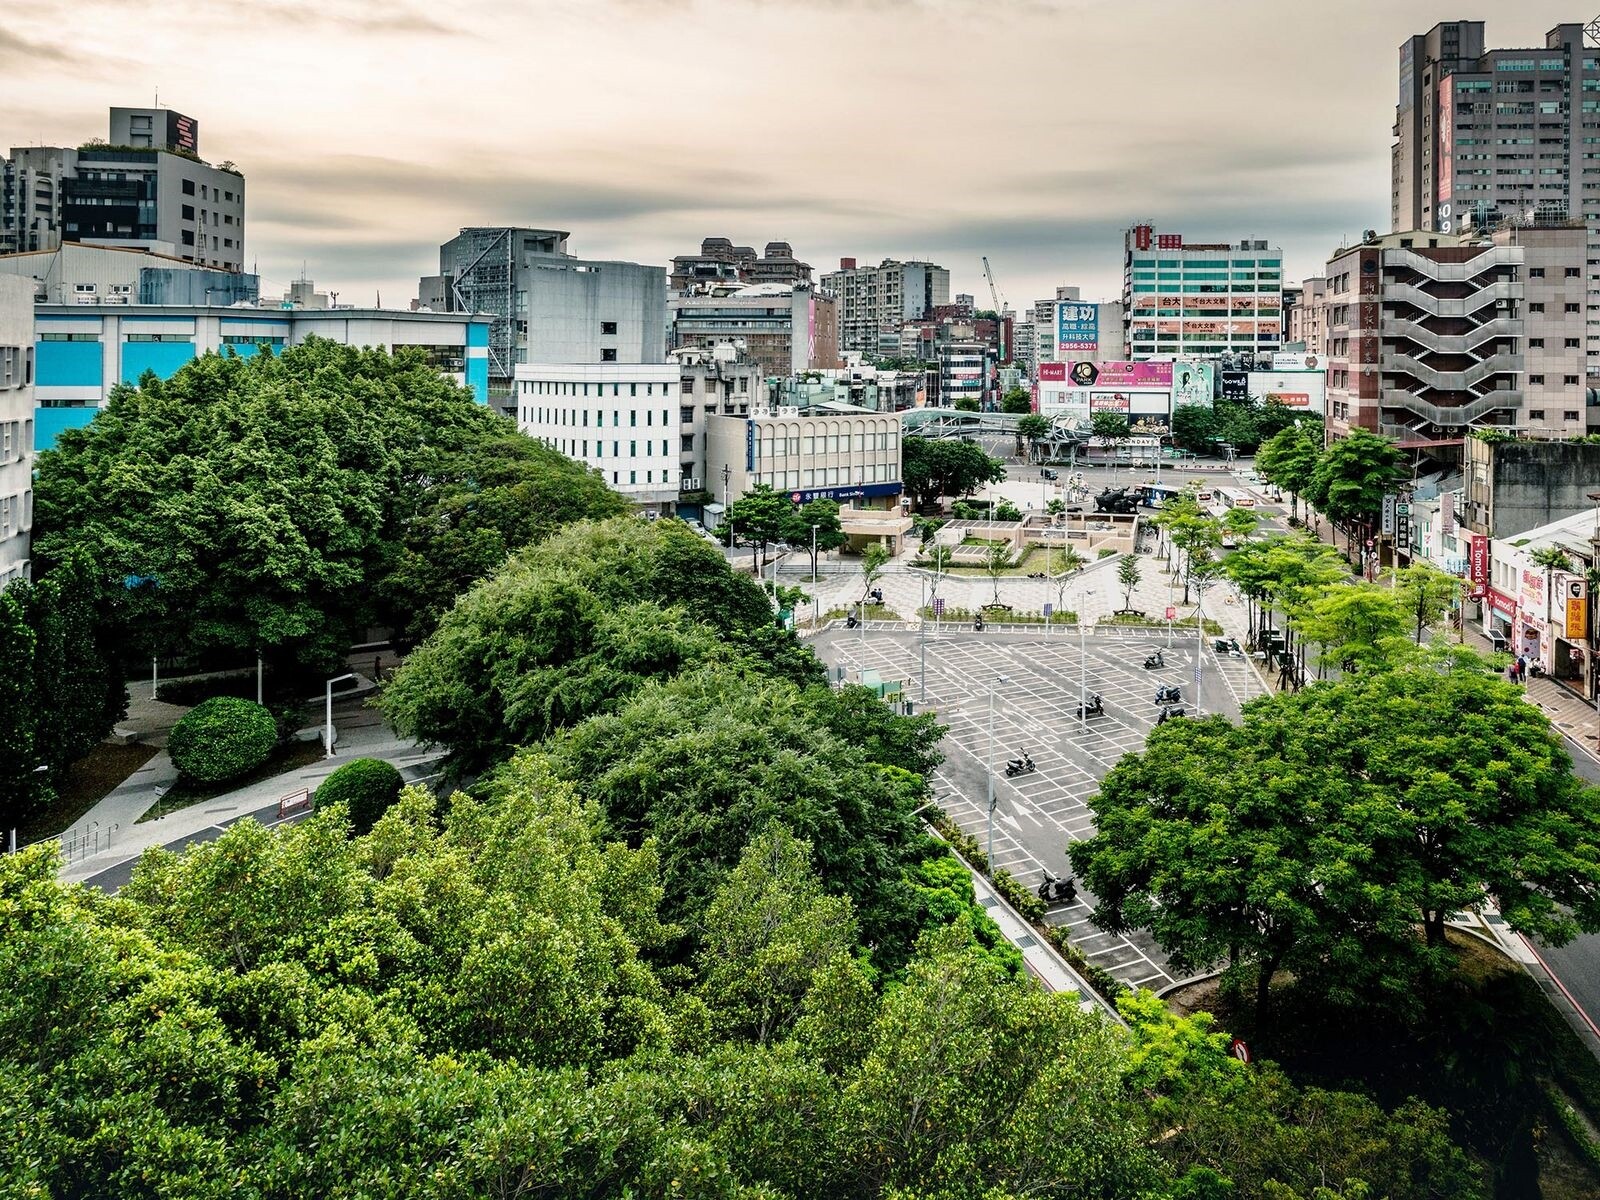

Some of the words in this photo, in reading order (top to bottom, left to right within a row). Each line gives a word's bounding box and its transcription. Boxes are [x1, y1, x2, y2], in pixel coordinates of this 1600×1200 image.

[1163, 297, 1181, 306] 台大
[1062, 306, 1095, 321] 建功
[1474, 549, 1485, 583] Tomod's
